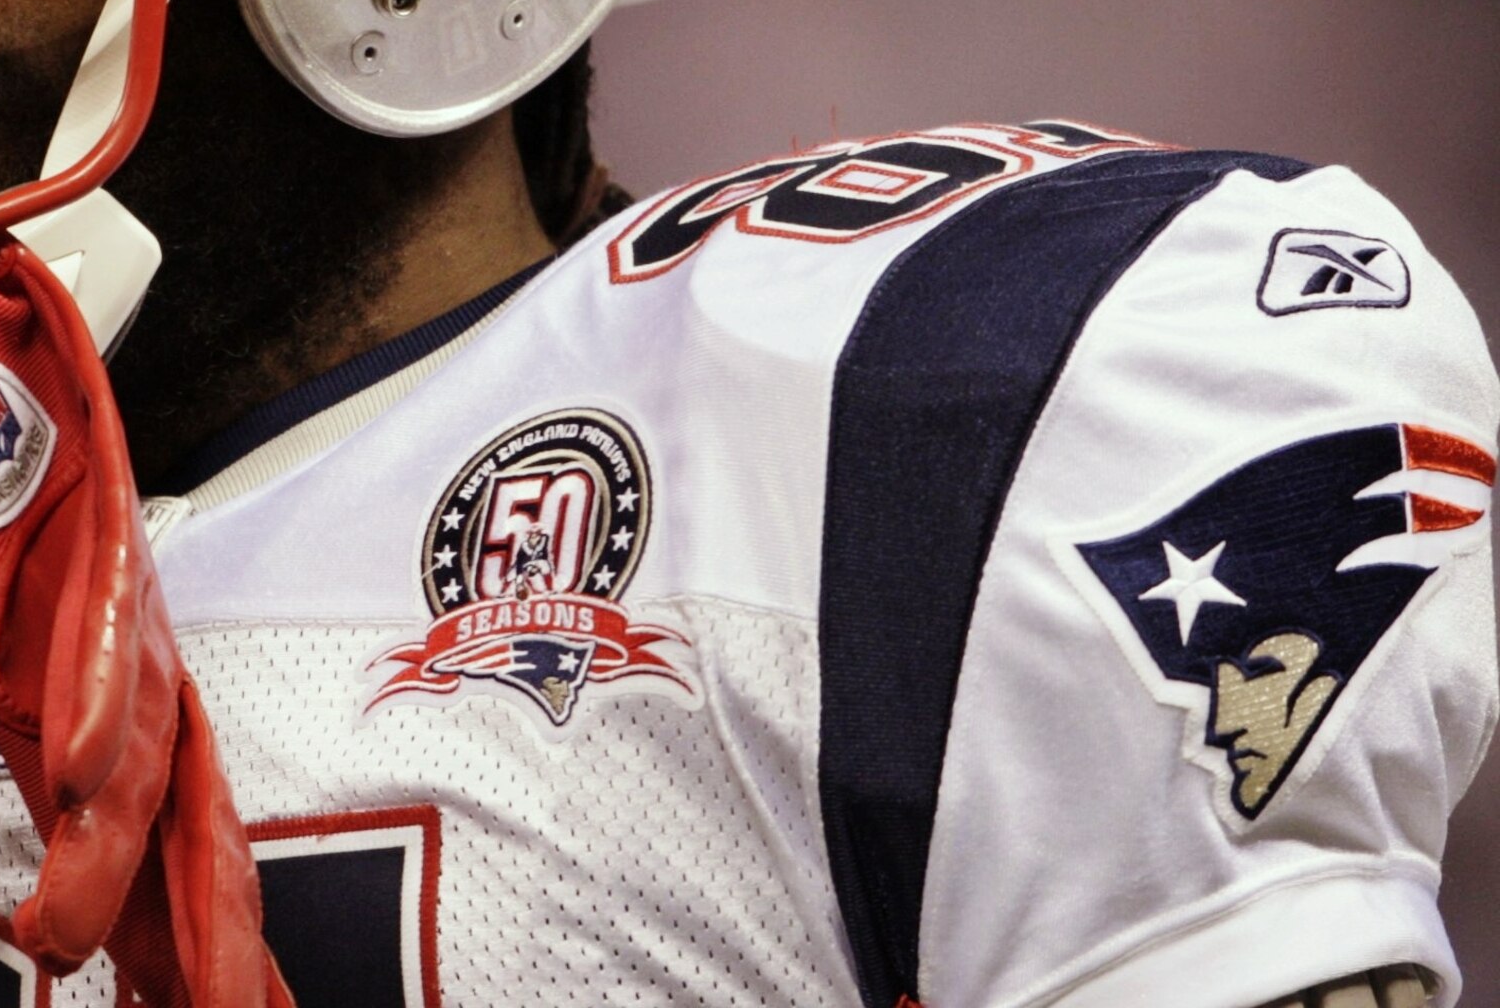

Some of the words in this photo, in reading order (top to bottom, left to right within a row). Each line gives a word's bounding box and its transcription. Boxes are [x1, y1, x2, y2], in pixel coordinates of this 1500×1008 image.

[459, 458, 498, 502] NEW
[496, 423, 580, 462] ENGLAND
[579, 425, 633, 483] PATRIOTS
[477, 467, 597, 598] 50
[455, 602, 595, 643] SEASONS
